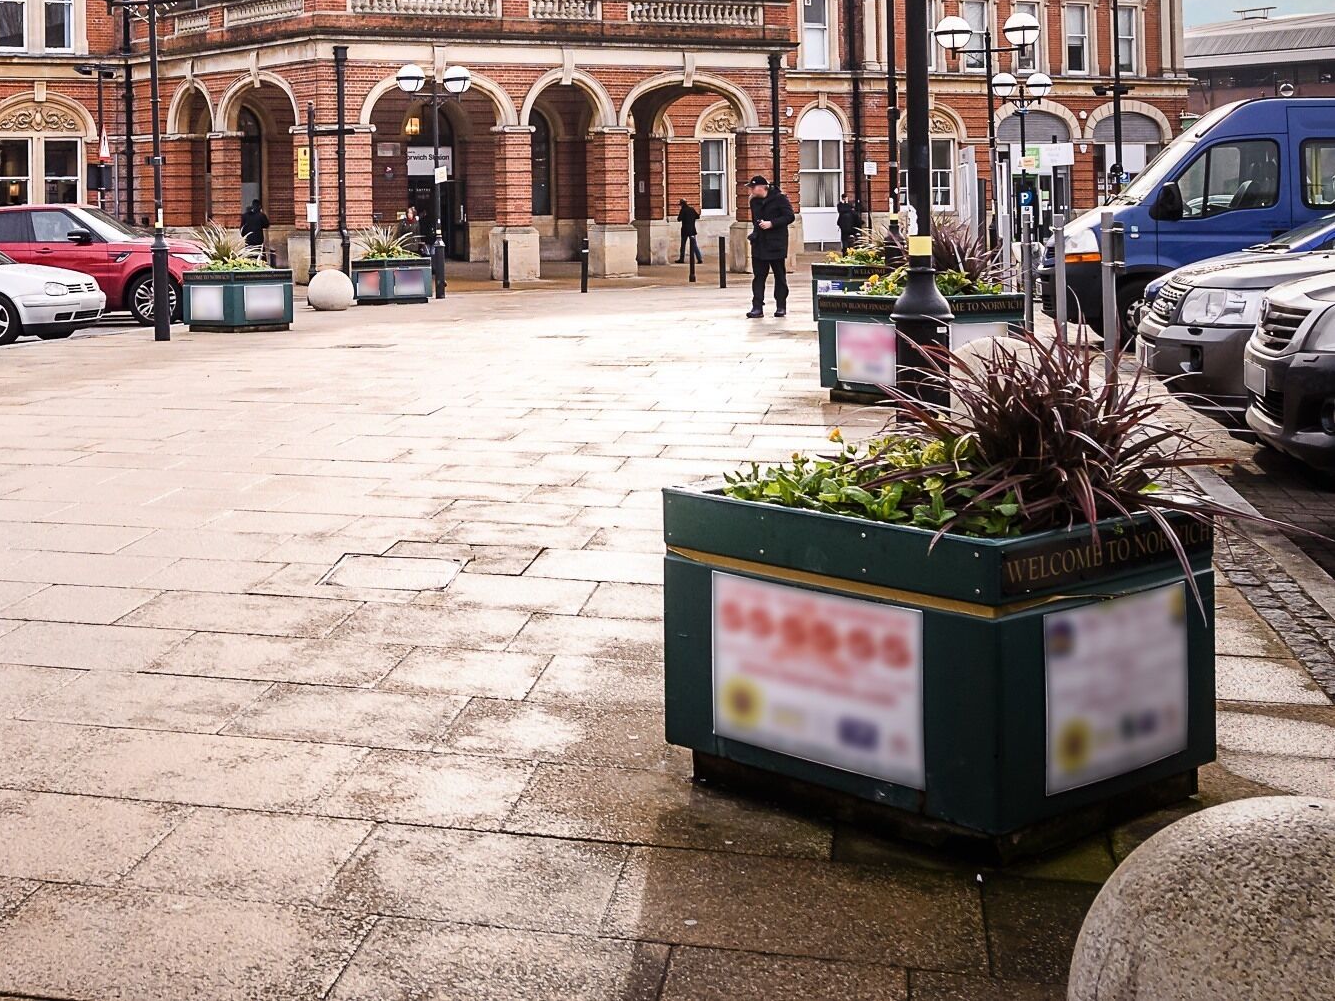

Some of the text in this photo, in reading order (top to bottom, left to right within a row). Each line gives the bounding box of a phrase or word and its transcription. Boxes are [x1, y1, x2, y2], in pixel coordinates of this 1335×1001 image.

[407, 153, 450, 161] orwich Sttion
[1020, 192, 1029, 204] P
[966, 302, 979, 312] TO
[980, 300, 1024, 311] NORWICH
[1007, 544, 1104, 583] WELCOME
[1106, 538, 1131, 563] TO
